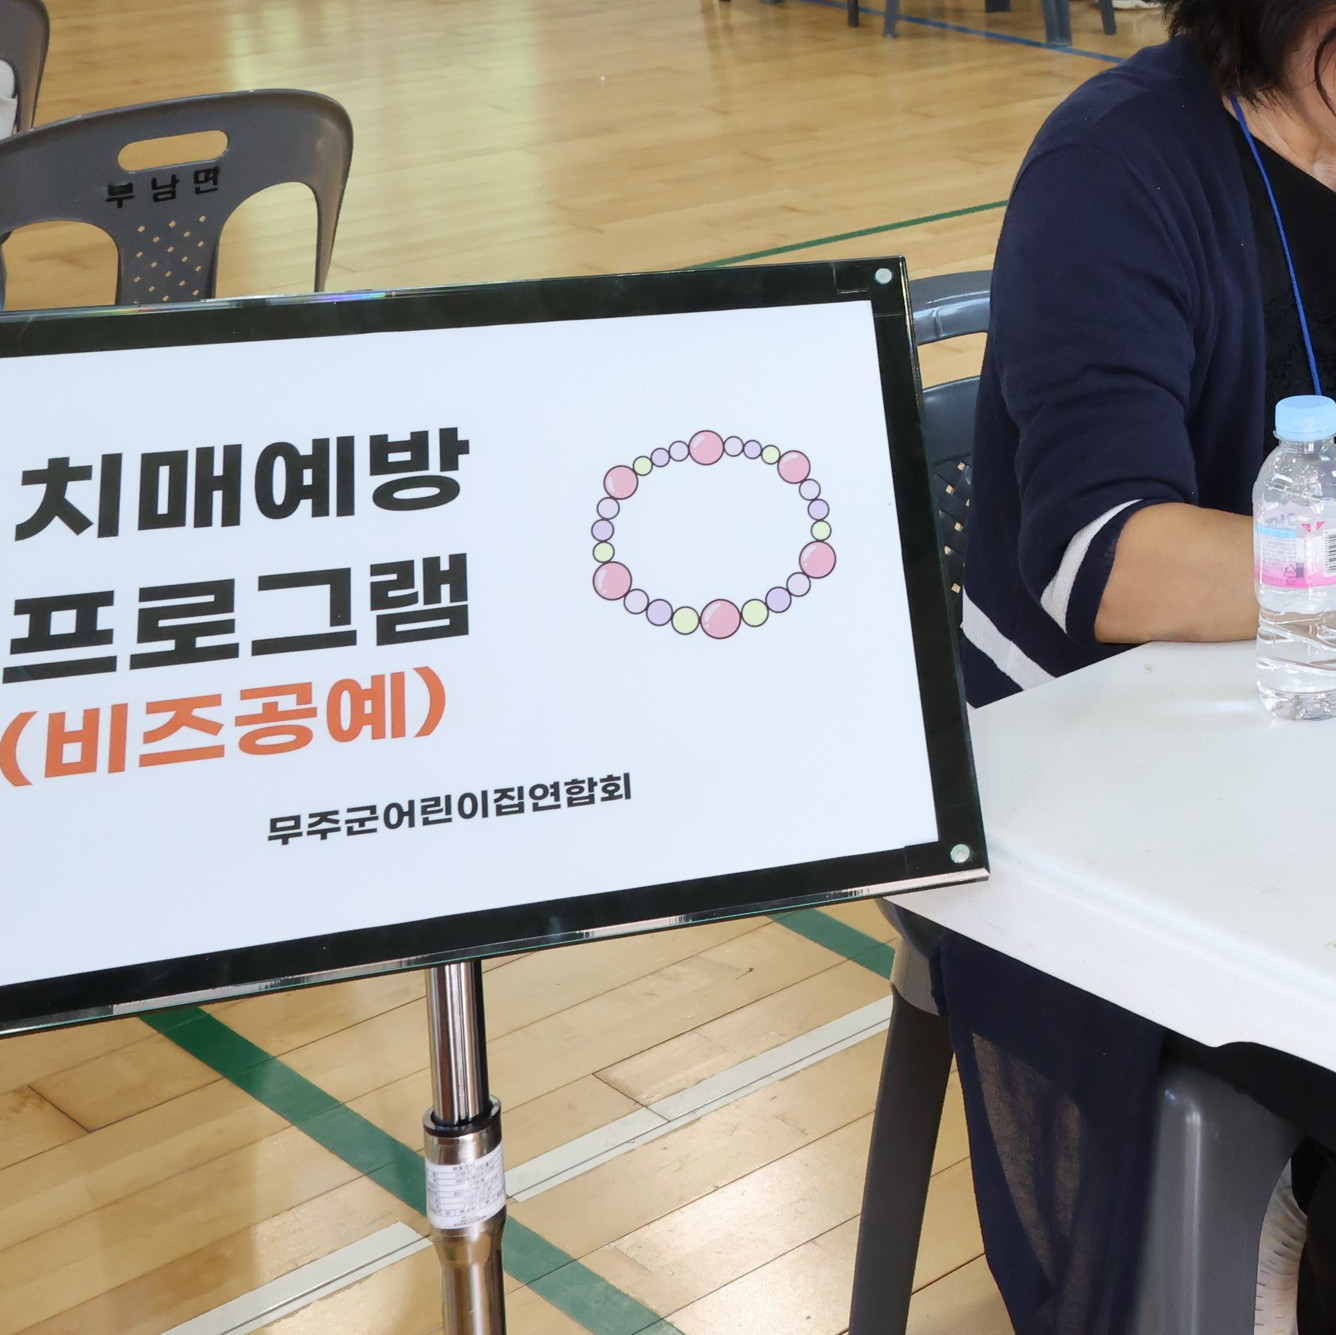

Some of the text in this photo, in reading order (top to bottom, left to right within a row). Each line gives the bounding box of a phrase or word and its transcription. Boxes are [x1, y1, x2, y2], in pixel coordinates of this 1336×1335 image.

[104, 165, 222, 209] 부남면
[14, 427, 470, 543] 치매예방
[2, 552, 470, 684] 프로그램
[0, 666, 447, 787] (비즈공예)
[266, 771, 633, 847] 무주군어린이집연합회
